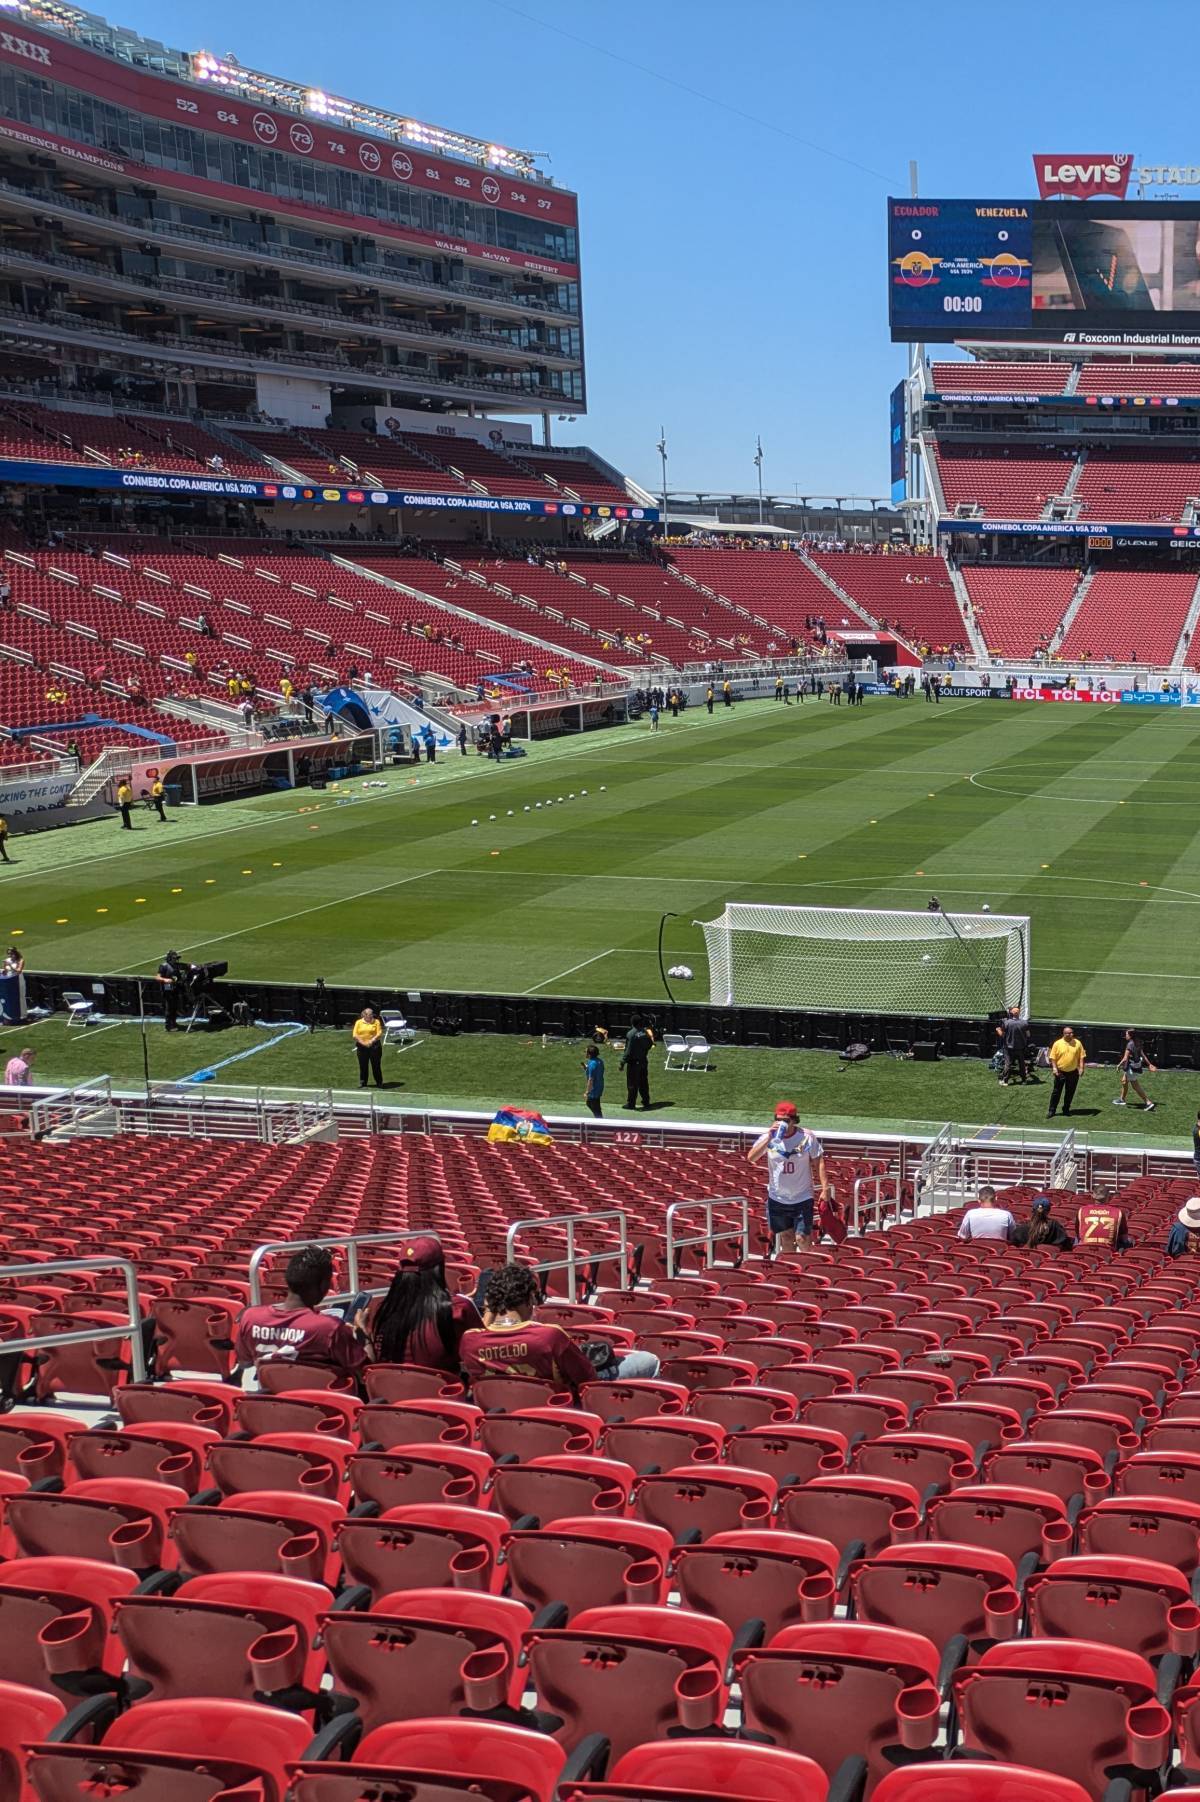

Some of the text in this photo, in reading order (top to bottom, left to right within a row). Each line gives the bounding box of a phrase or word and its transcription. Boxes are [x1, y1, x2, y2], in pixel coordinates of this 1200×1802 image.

[176, 97, 199, 114] 52
[217, 110, 239, 125] 64
[255, 121, 276, 134] 70
[292, 131, 313, 145] 73
[327, 141, 346, 155] 74
[60, 145, 125, 172] CHAMPIONS
[360, 149, 379, 163] 79
[392, 159, 412, 173] 80
[426, 168, 440, 180] 81
[454, 176, 471, 188] 82
[483, 184, 498, 195] 87
[511, 191, 527, 203] 94
[894, 206, 939, 217] ECUADOR
[975, 208, 1028, 217] VENEZUELA
[911, 229, 922, 240] 0
[998, 230, 1009, 241] 0
[435, 240, 468, 254] WALSH
[524, 261, 559, 274] SEIFERT
[943, 296, 983, 312] 00:00
[1079, 333, 1121, 343] Foxconn
[1123, 333, 1170, 344] Industrial
[123, 474, 169, 488] CONMEBOL
[169, 478, 191, 490] COPA
[190, 479, 224, 493] AMERICA
[225, 482, 239, 493] USA
[240, 484, 257, 494] 2024
[403, 495, 530, 511] CONMEBOL COPA AMERICA USA 2024
[982, 523, 1022, 531] CONMEBOL
[965, 689, 991, 697] SPORT
[1013, 689, 1044, 700] TCL
[1051, 690, 1082, 701] TCL
[1090, 691, 1120, 702] TCL
[1123, 693, 1155, 702] BYD
[29, 787, 48, 798] THE
[616, 1132, 639, 1142] 127
[478, 1343, 527, 1360] SOTELDO
